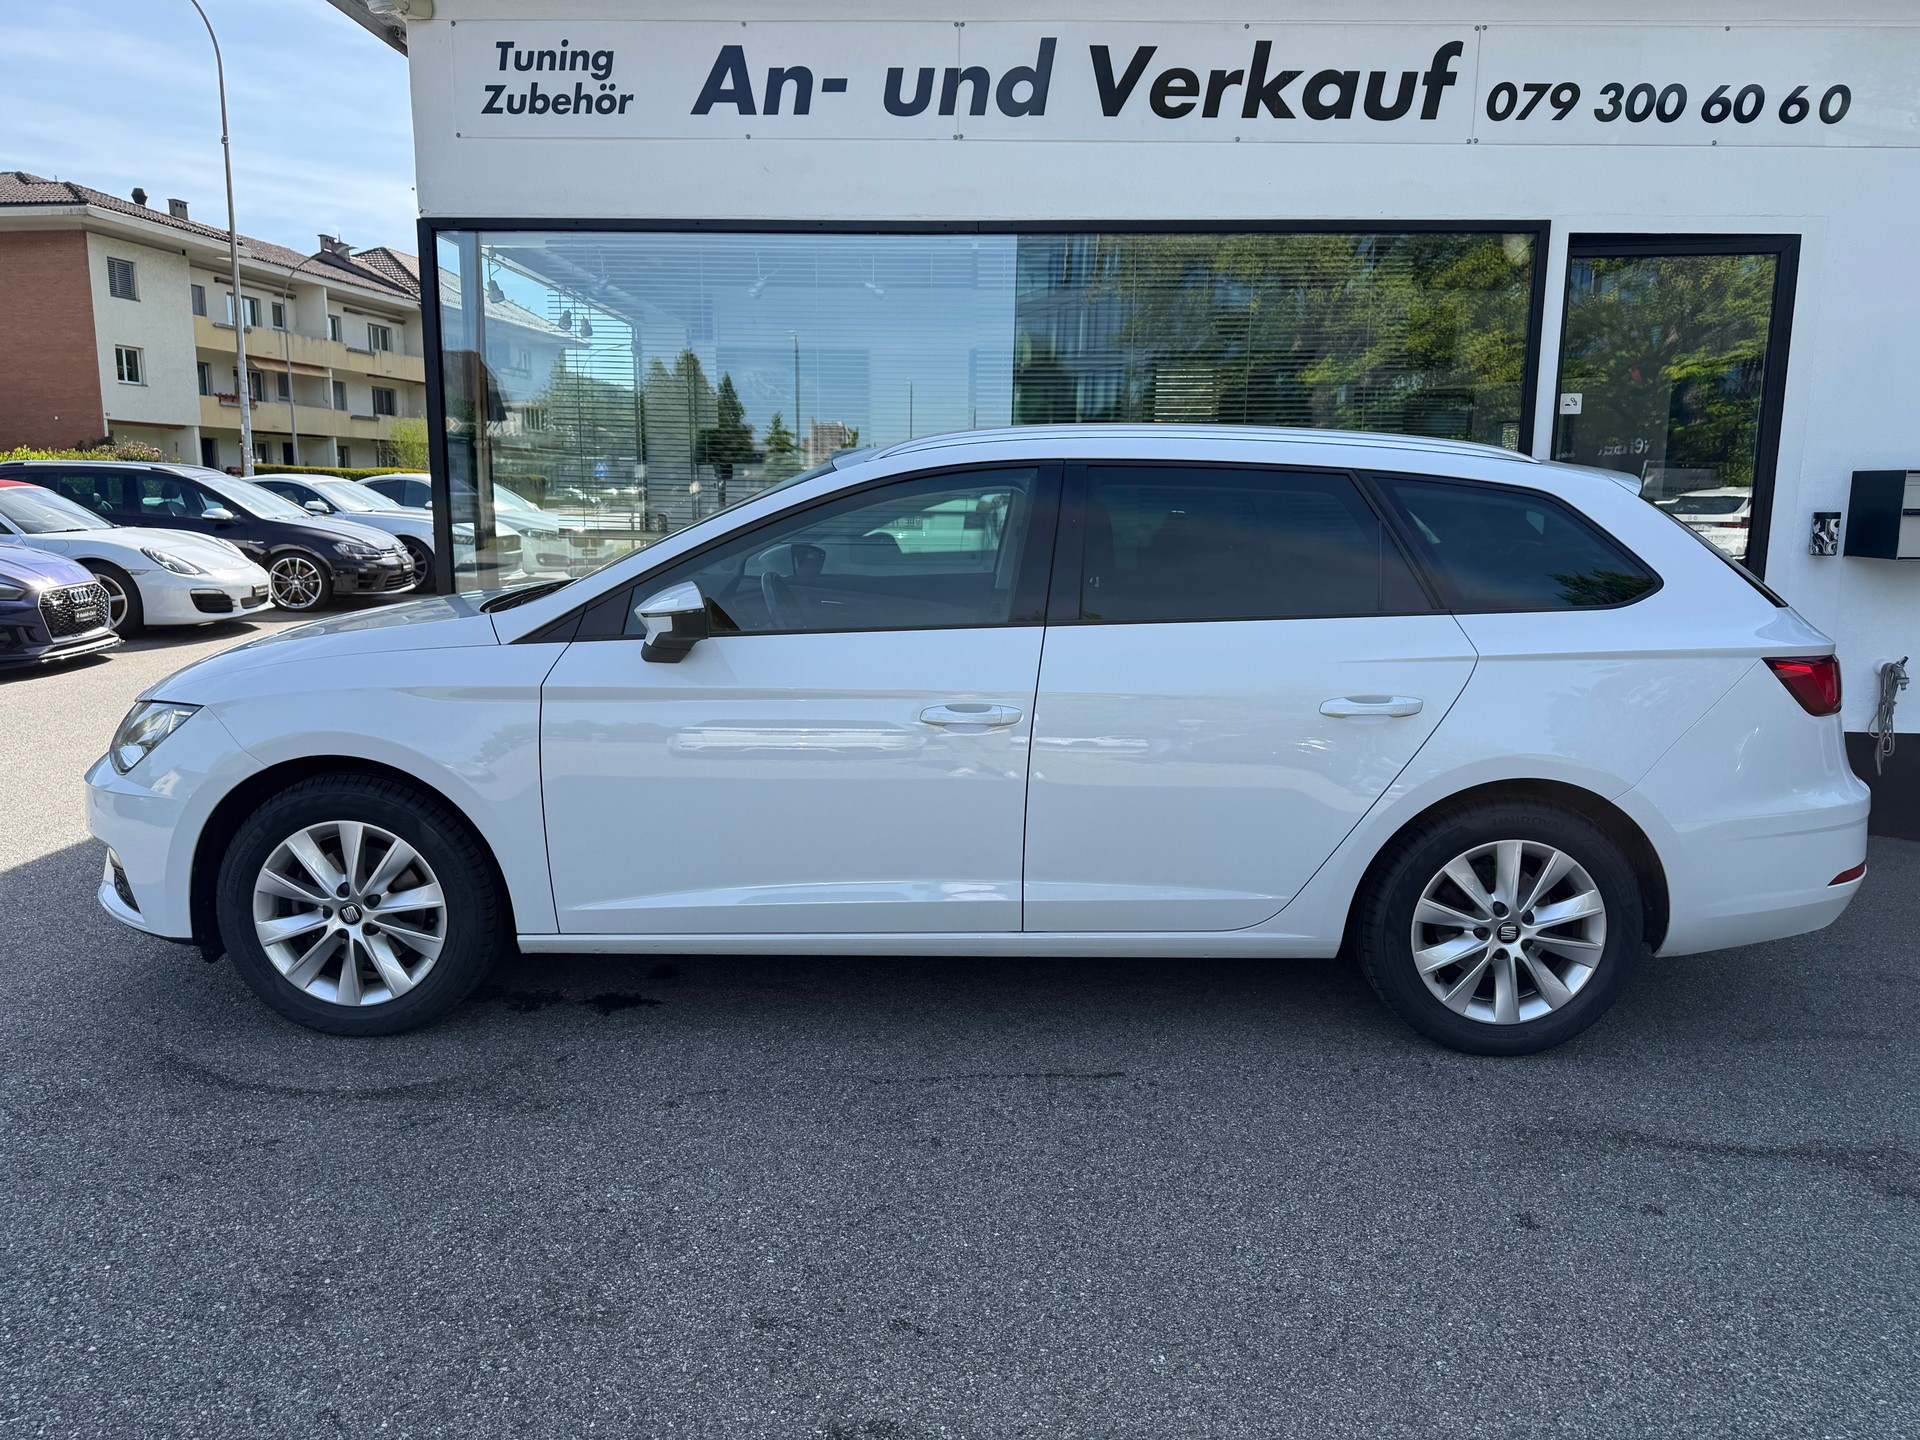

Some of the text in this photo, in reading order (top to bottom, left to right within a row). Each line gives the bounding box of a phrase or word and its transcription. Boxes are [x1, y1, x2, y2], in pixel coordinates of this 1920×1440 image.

[495, 38, 615, 82] Tuning
[689, 36, 1465, 122] An- und Verkauf
[480, 81, 635, 115] Zubehör
[1486, 81, 1581, 122] 079
[1593, 82, 1688, 124] 300
[1700, 83, 1766, 125] 60
